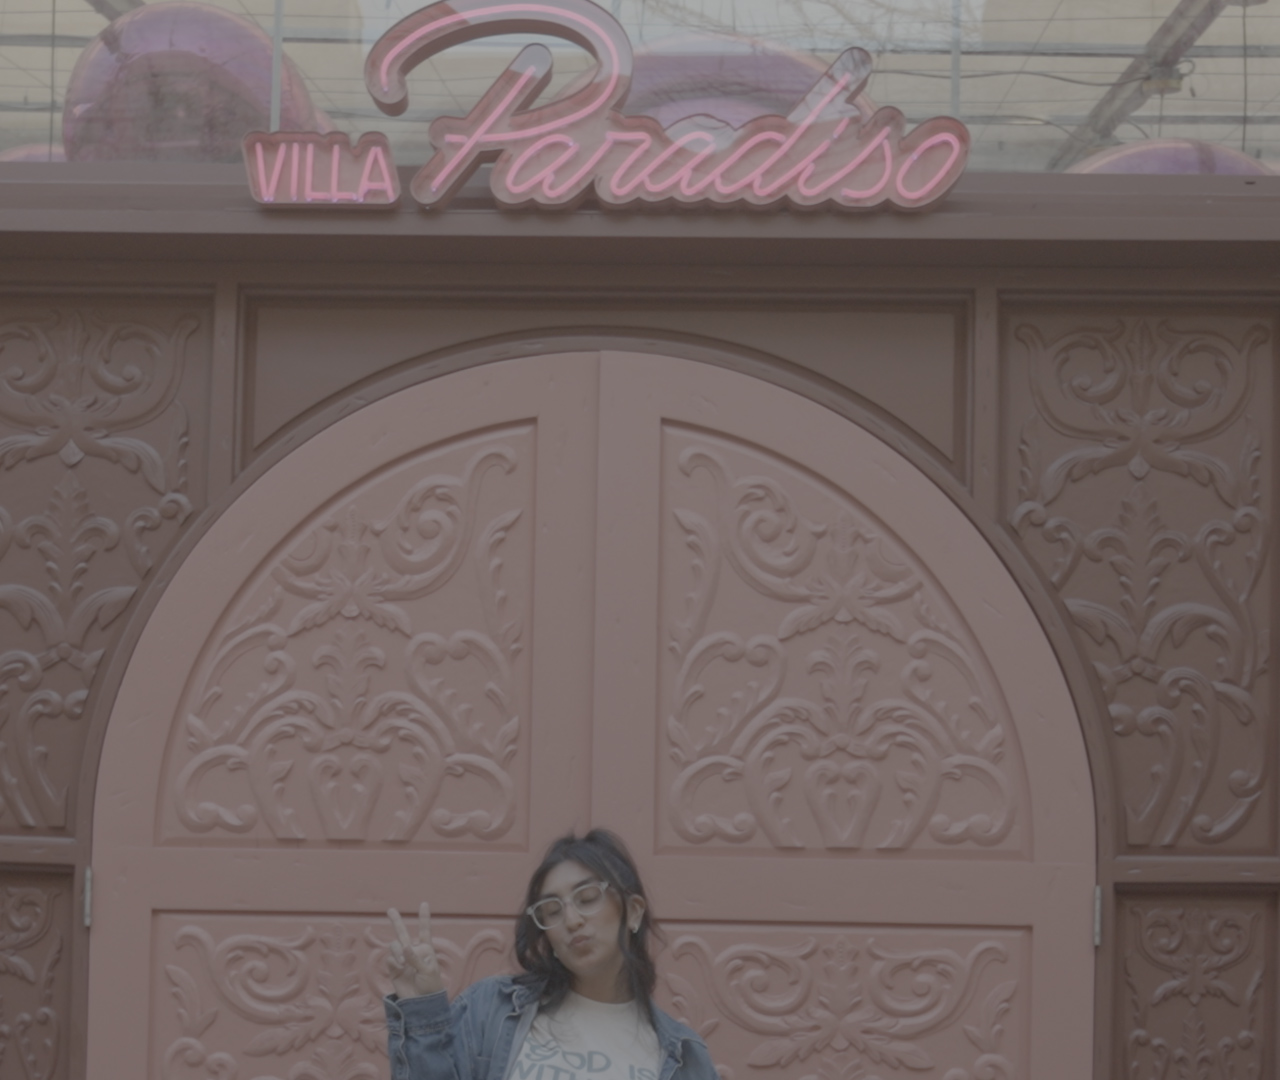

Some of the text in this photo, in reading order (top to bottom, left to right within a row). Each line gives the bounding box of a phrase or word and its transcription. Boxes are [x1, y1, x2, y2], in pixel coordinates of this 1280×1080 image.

[250, 0, 969, 208] VILLA Paradiso
[524, 1037, 612, 1073] GOD
